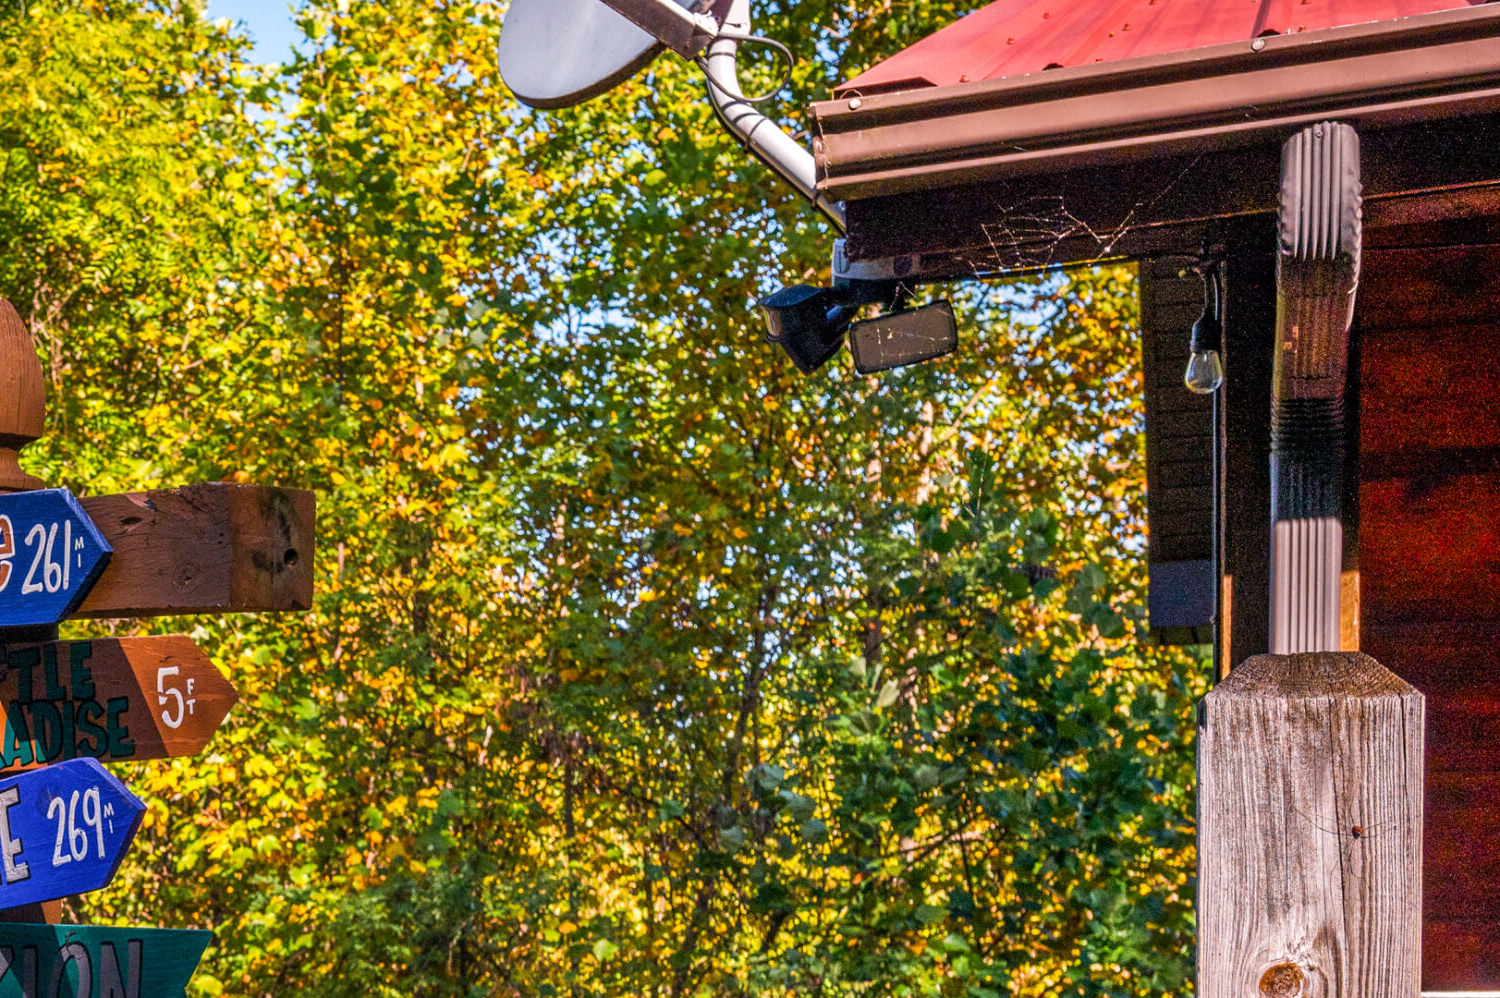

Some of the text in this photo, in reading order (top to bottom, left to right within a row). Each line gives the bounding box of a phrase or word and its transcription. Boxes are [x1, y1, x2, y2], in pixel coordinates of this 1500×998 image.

[20, 519, 71, 595] 261
[156, 665, 184, 729] 5
[46, 786, 105, 868] 269
